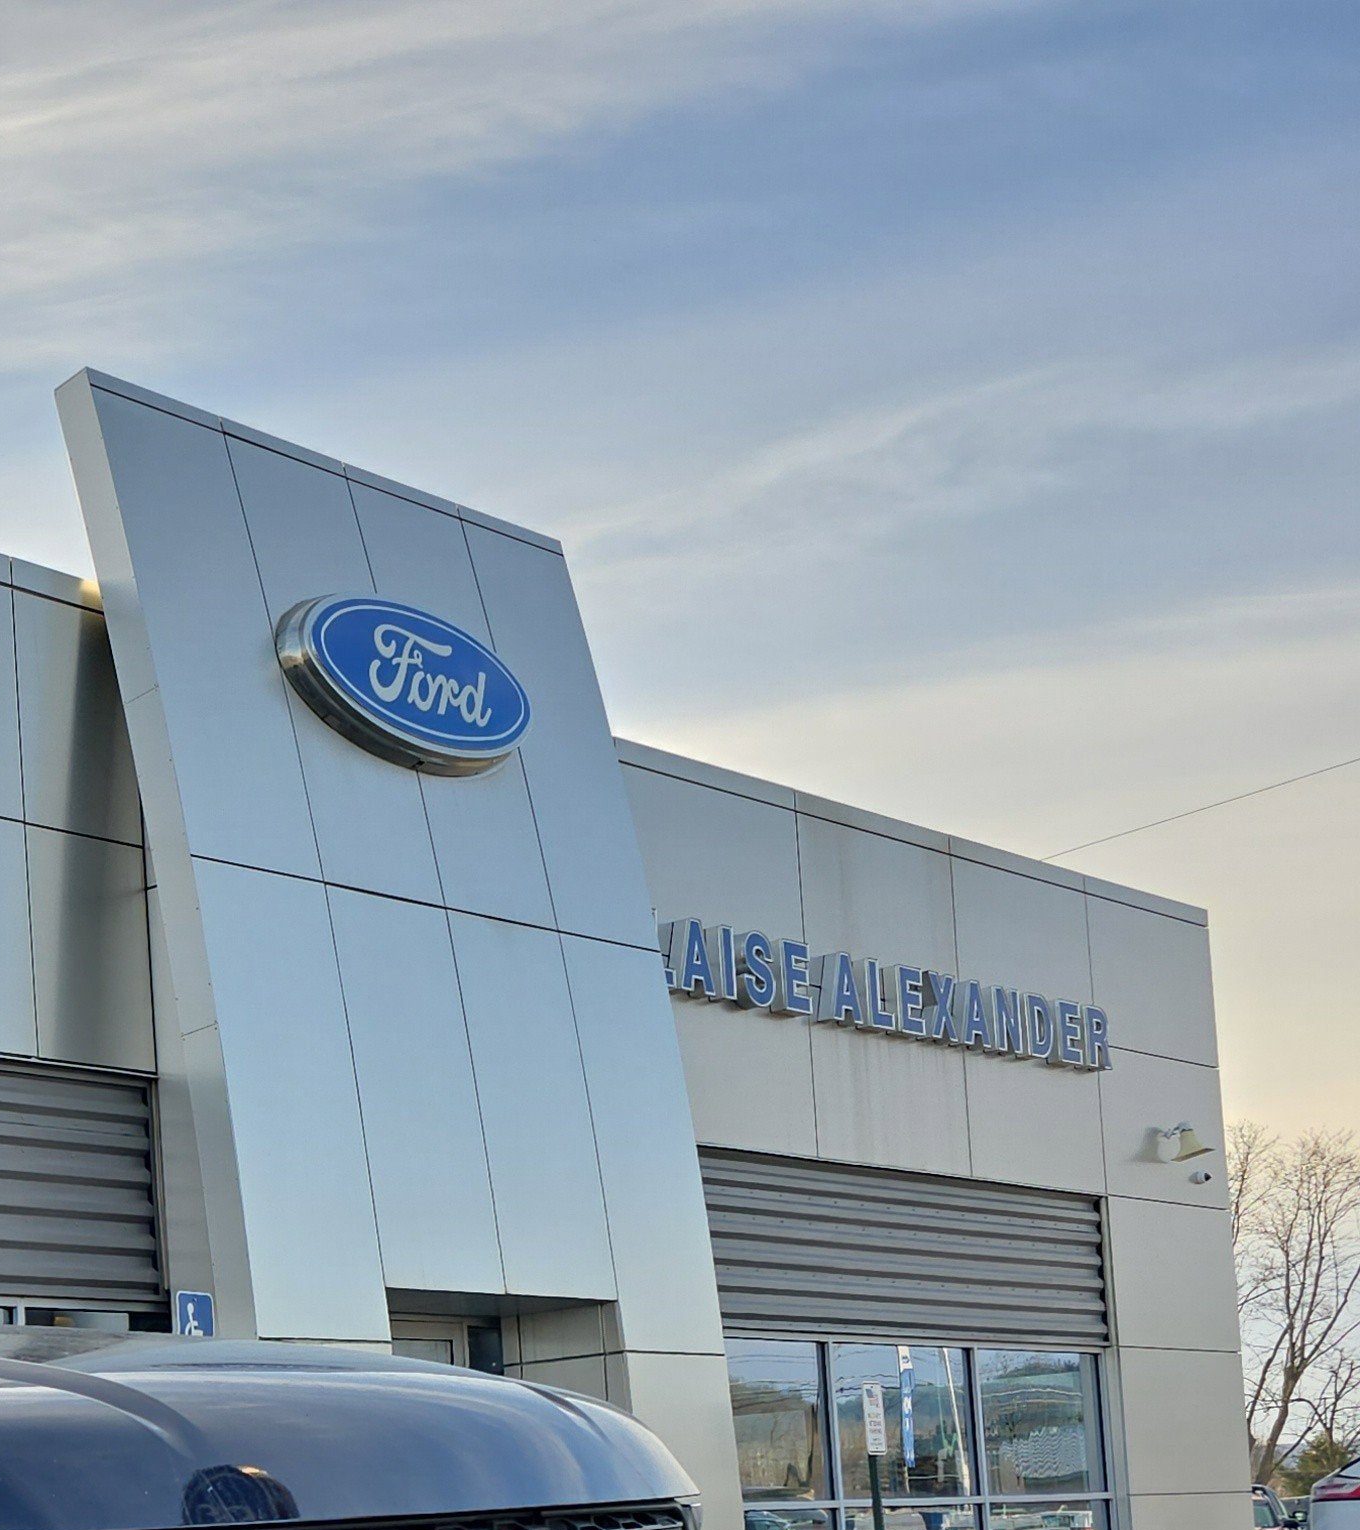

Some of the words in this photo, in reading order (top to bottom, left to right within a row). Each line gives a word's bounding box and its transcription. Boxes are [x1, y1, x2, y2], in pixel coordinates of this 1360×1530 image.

[368, 623, 493, 728] Ford
[665, 917, 814, 1015] AISE
[832, 951, 1114, 1070] ALEXANDER
